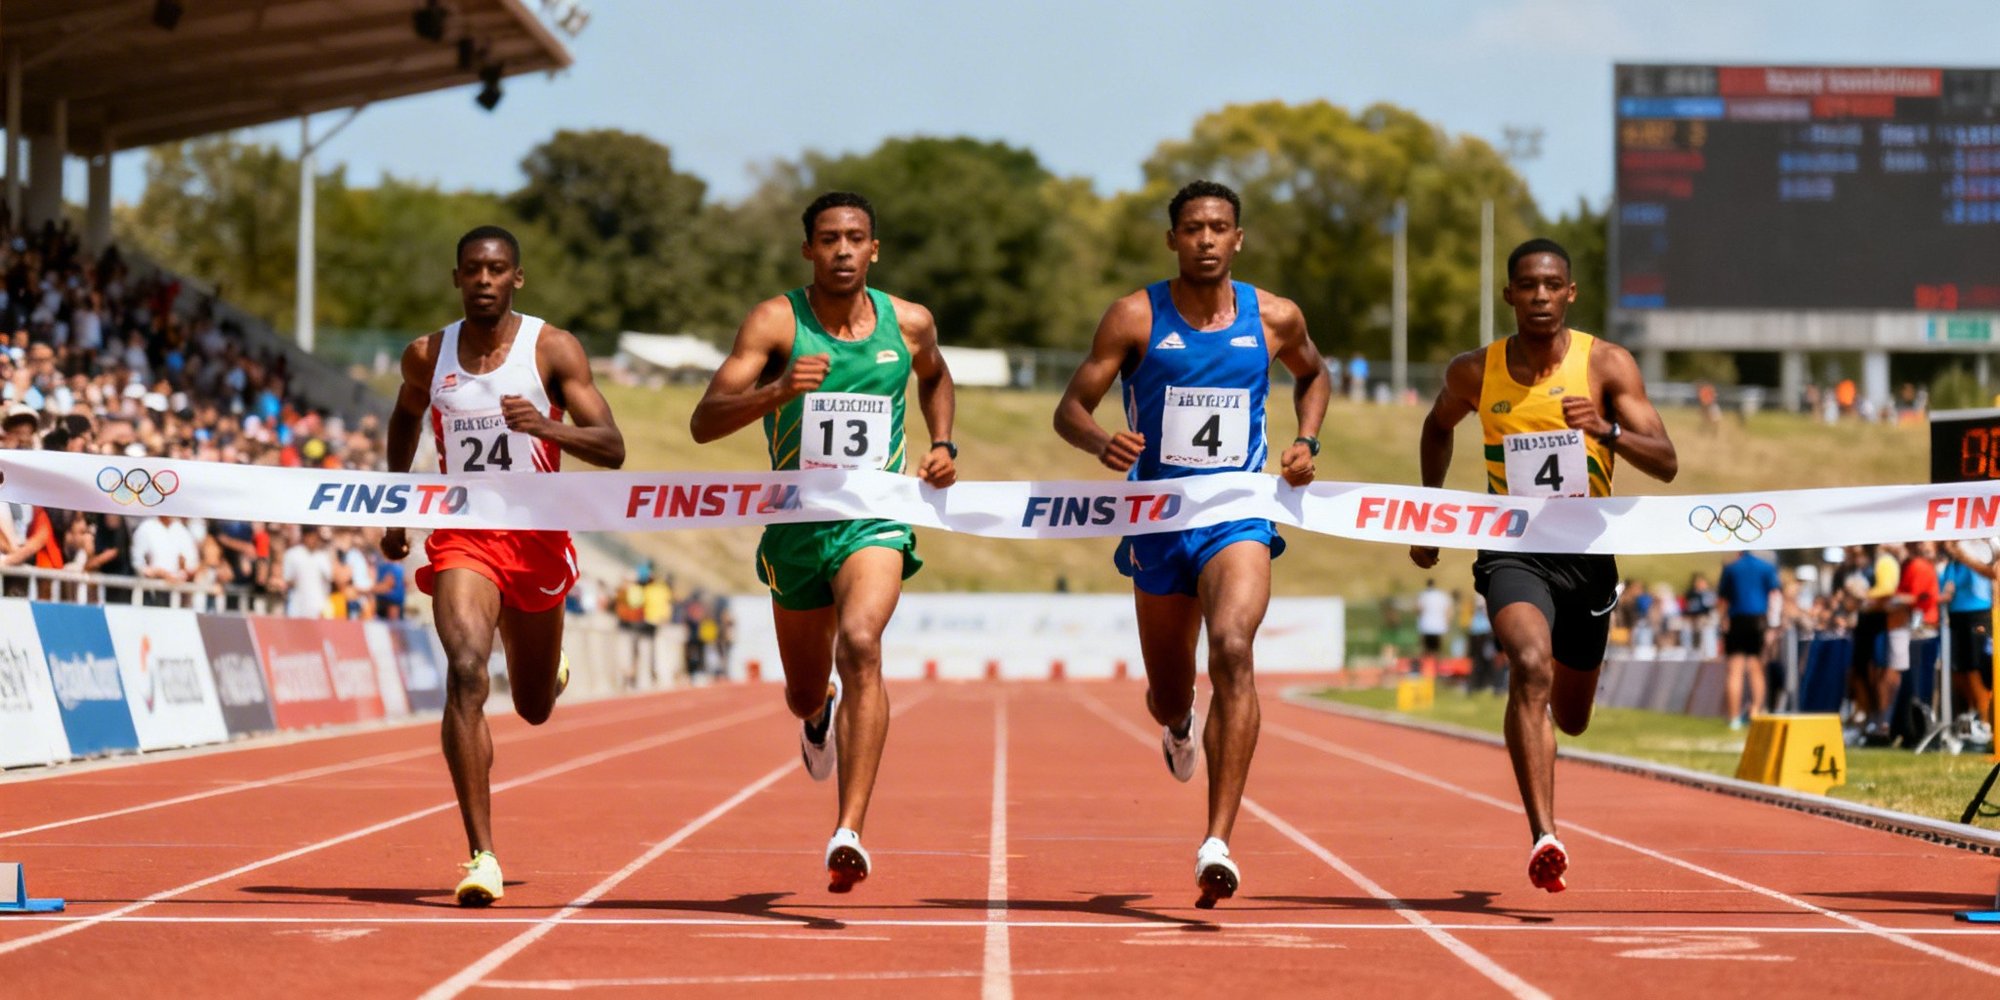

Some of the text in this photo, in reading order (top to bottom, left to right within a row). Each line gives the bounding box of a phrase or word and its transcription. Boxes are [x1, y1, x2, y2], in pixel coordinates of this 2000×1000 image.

[460, 432, 513, 472] 24
[819, 419, 869, 457] 13
[1192, 414, 1222, 457] 4
[1534, 453, 1564, 491] 4
